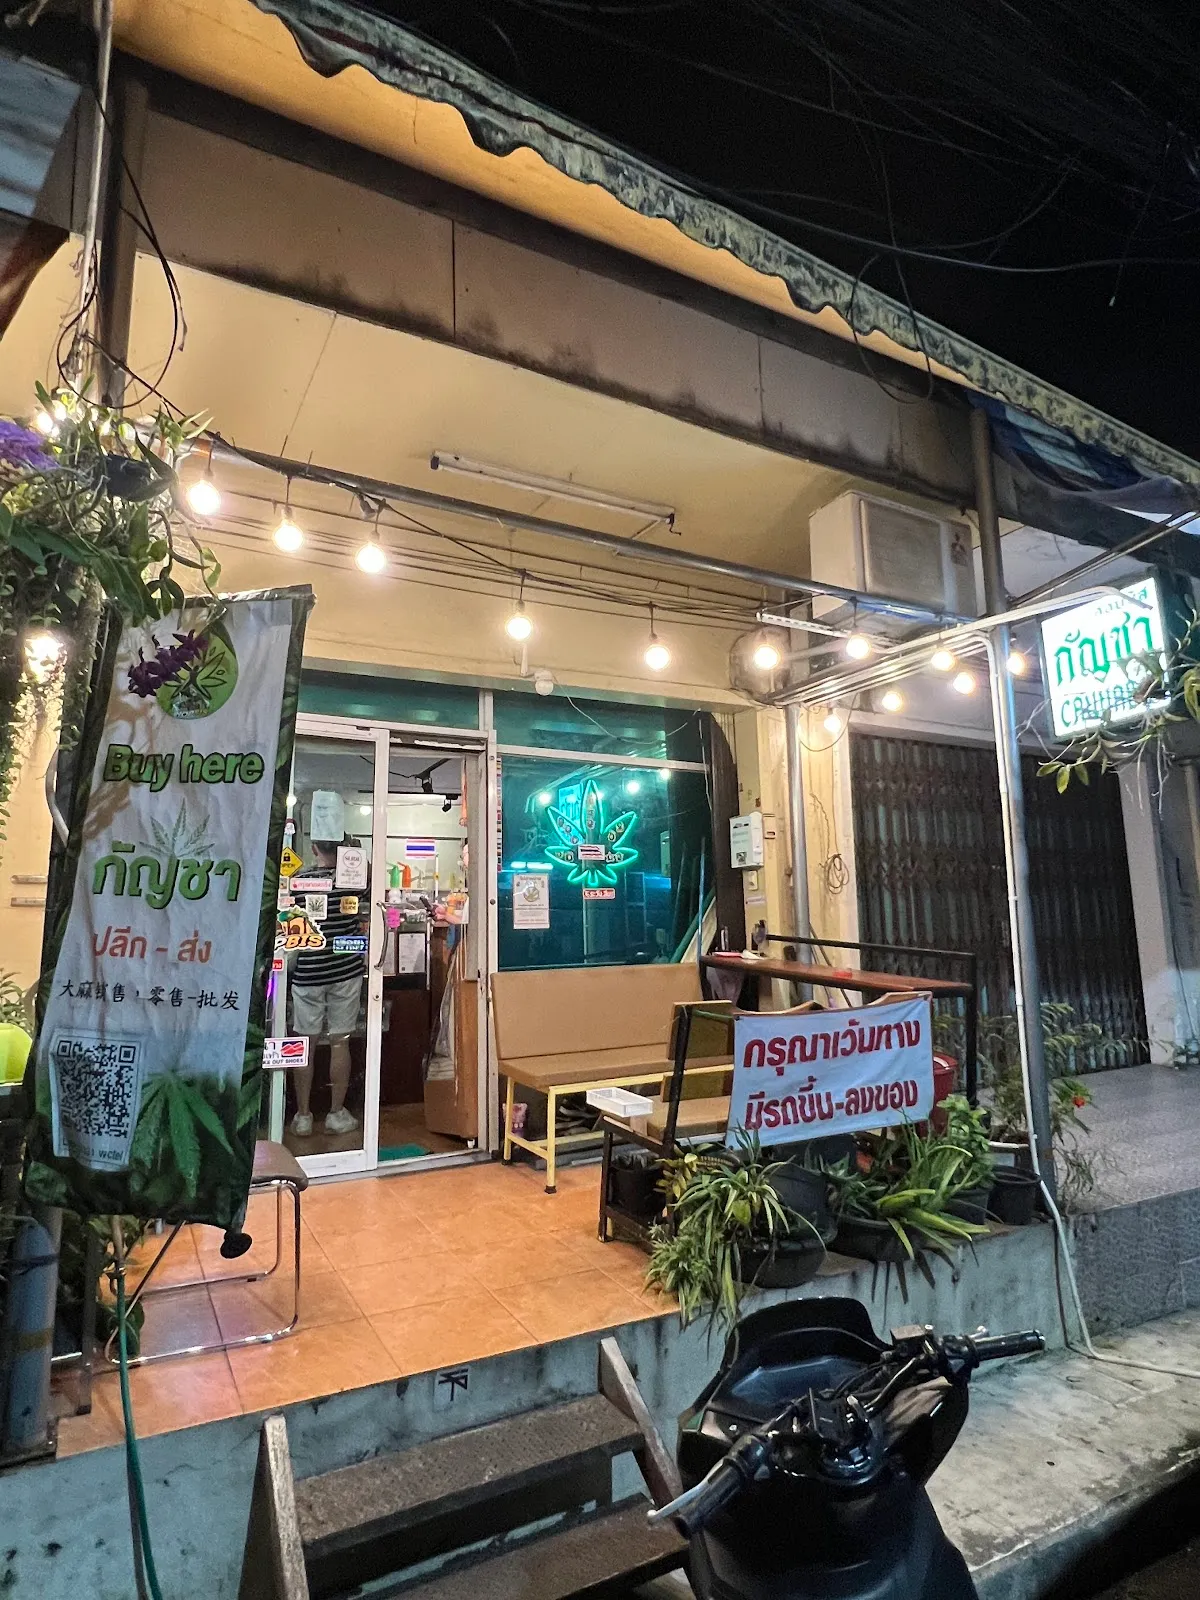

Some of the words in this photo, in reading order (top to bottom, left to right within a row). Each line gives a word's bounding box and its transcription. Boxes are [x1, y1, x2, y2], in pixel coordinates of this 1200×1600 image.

[1053, 611, 1154, 686] กัญชา
[103, 743, 174, 792] Buy
[179, 744, 265, 784] here
[92, 925, 148, 959] ปลีก
[177, 929, 212, 963] ส่ง
[743, 1018, 921, 1076] กรุณาเว้นทาง
[744, 1075, 919, 1131] มีรถขึ้น-ลงของ
